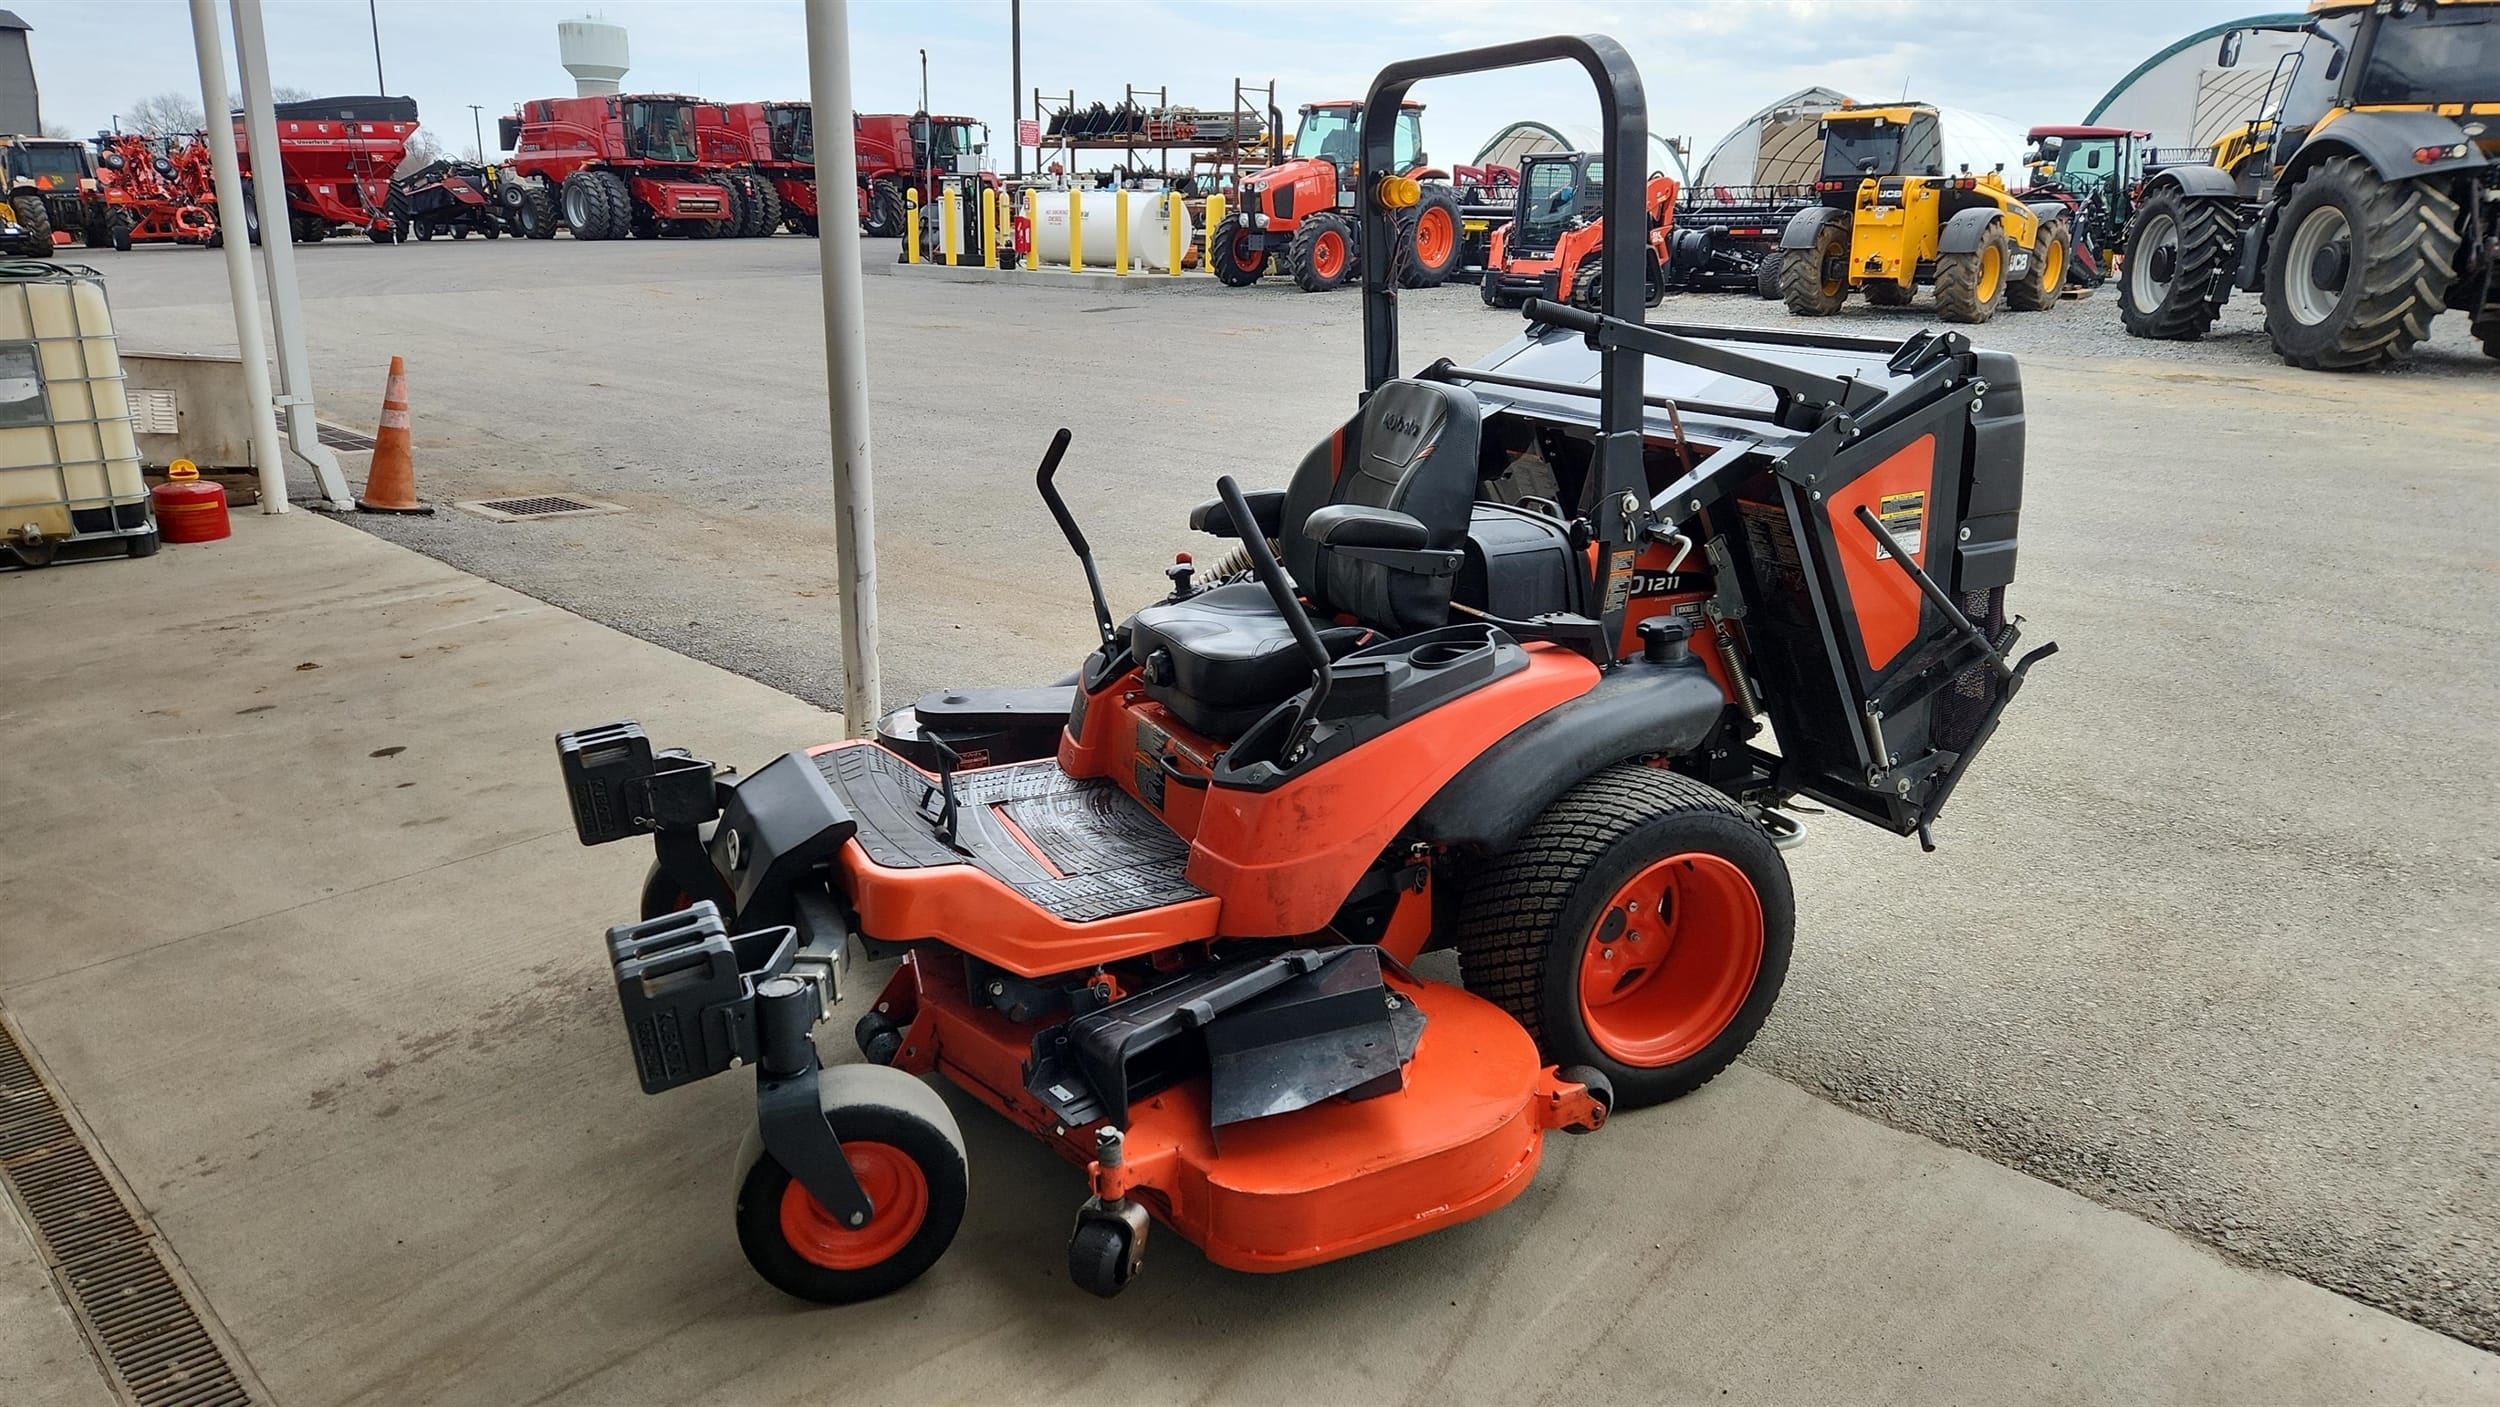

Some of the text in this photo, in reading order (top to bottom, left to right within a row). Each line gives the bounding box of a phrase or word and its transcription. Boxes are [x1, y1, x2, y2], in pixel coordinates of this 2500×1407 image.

[1878, 190, 1902, 198] JCB
[956, 201, 962, 210] 2
[2009, 253, 2028, 272] JCB
[1382, 410, 1420, 437] Kubota
[1647, 576, 1681, 592] 1211
[657, 1008, 686, 1077] KUBOTA
